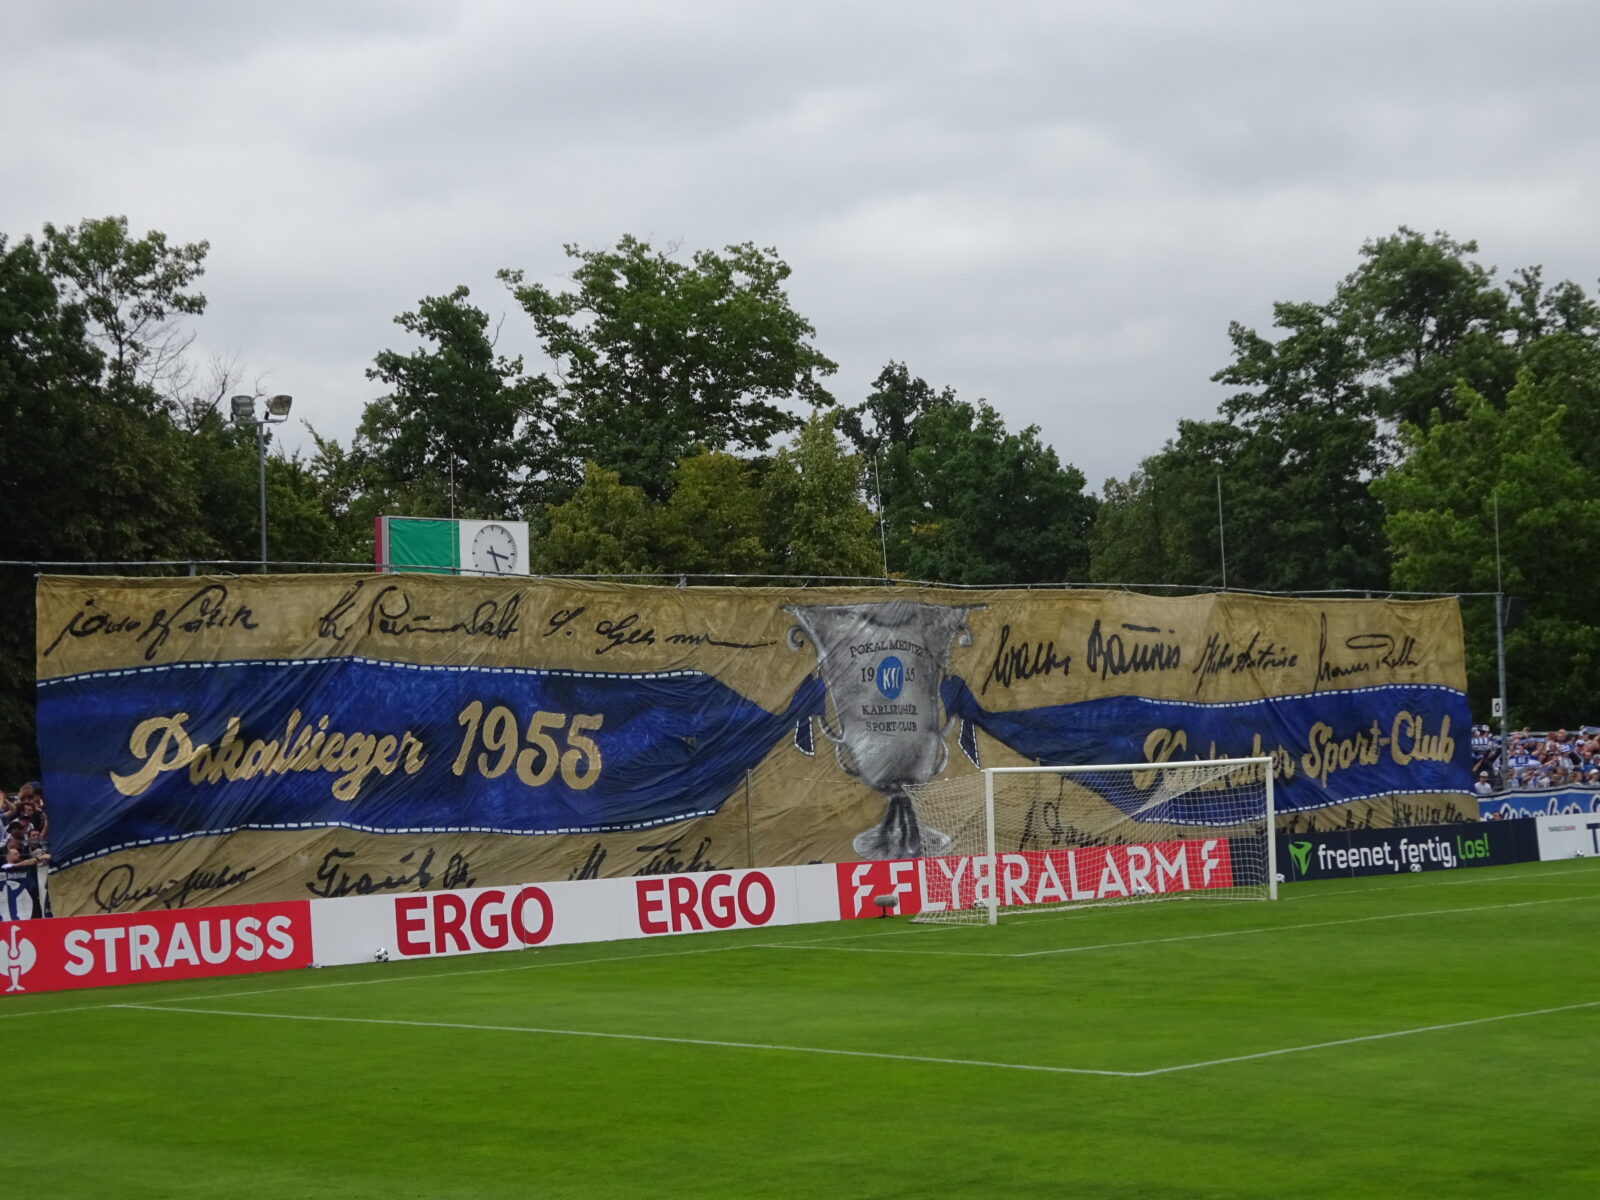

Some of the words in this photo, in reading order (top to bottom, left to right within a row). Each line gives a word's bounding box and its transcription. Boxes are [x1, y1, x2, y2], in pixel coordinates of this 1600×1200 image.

[849, 640, 888, 658] POKAL
[861, 667, 875, 682] 19
[883, 667, 901, 690] KSC
[111, 710, 426, 801] Pokalsieger
[450, 700, 605, 790] 1955
[1302, 711, 1455, 788] Sport-Club
[889, 843, 1190, 914] FLYERALARM
[1318, 842, 1399, 872] freenet,
[1400, 836, 1457, 868] fertig,
[1457, 833, 1490, 860] los!
[396, 885, 553, 957] ERGO
[636, 869, 775, 935] ERGO
[63, 915, 294, 976] STRAUSS
